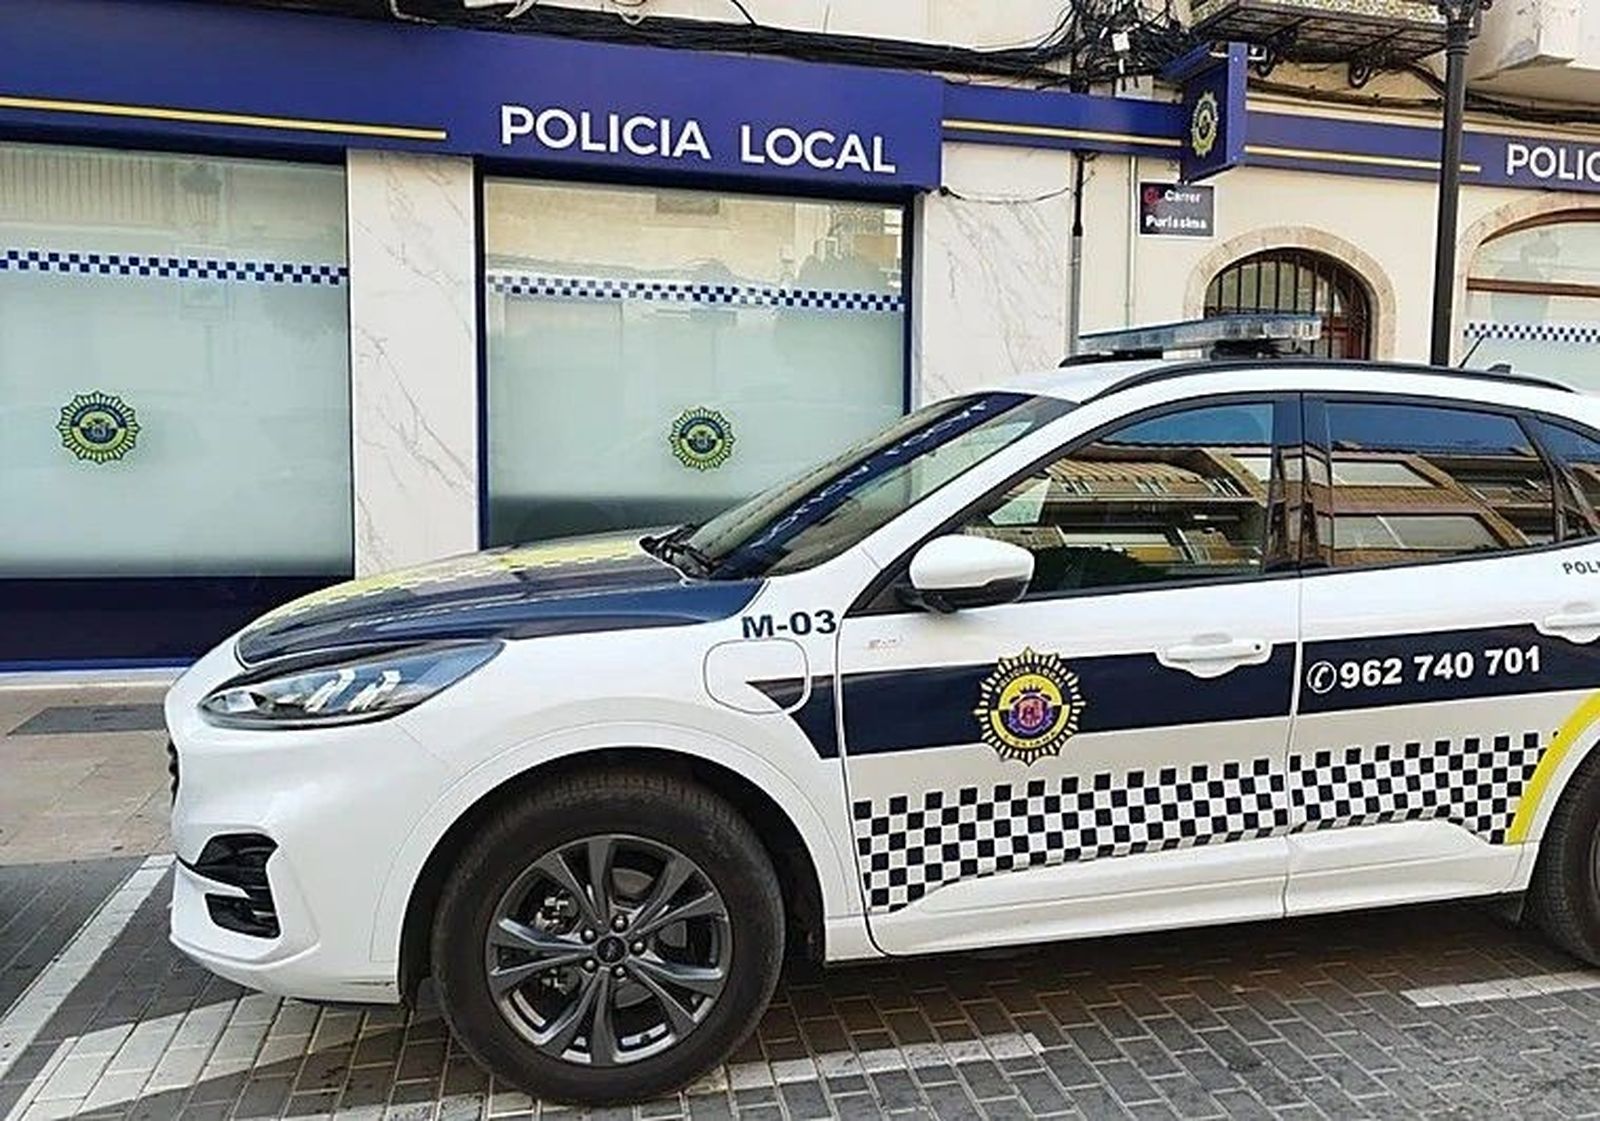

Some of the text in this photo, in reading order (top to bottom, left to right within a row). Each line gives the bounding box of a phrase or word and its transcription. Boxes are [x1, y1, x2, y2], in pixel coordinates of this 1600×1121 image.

[502, 105, 896, 173] POLICIA LOCAL
[742, 609, 837, 638] M-03
[1340, 646, 1540, 689] 962 740 701
